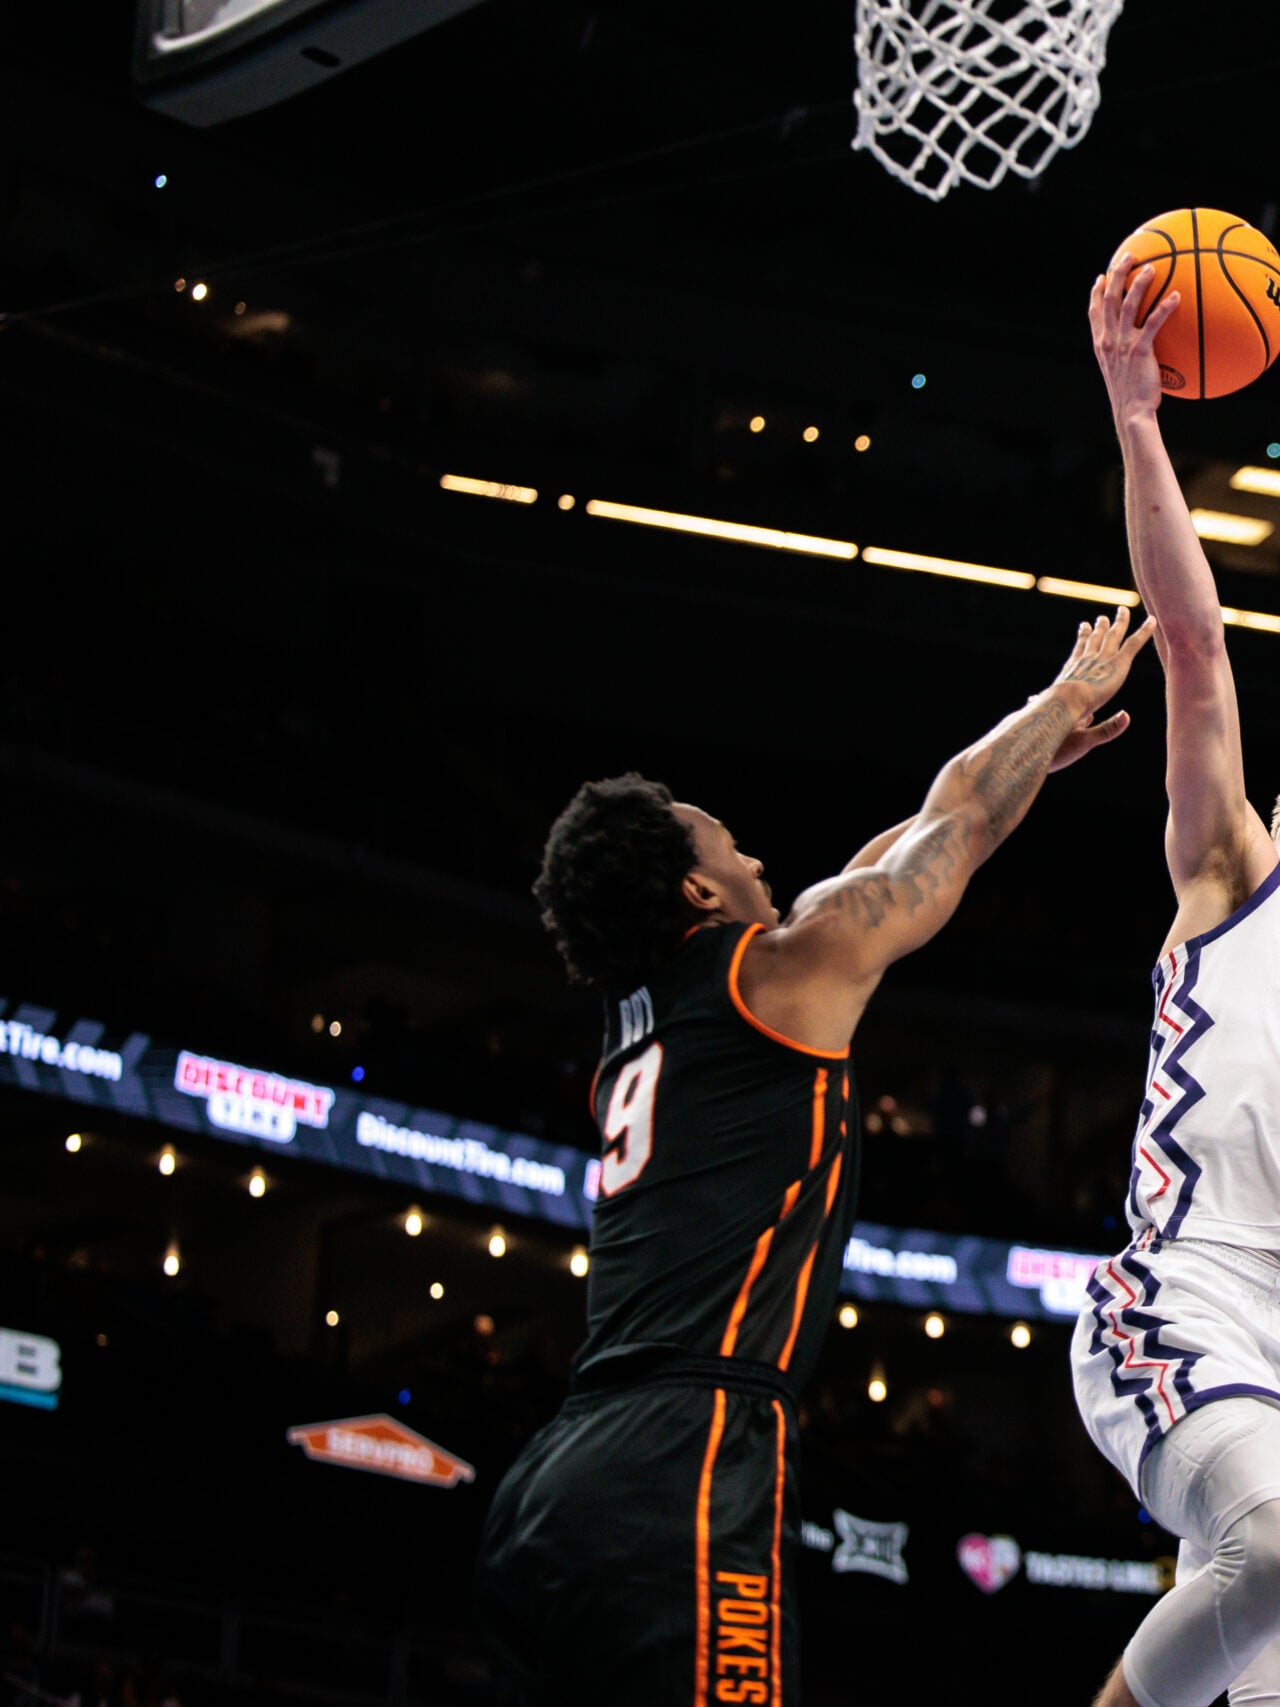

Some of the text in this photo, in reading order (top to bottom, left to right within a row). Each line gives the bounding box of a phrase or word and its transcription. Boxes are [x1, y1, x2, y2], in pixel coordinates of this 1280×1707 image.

[356, 1111, 565, 1196] DiscountTire.com
[601, 1040, 664, 1198] 9
[715, 1570, 769, 1705] POKES
